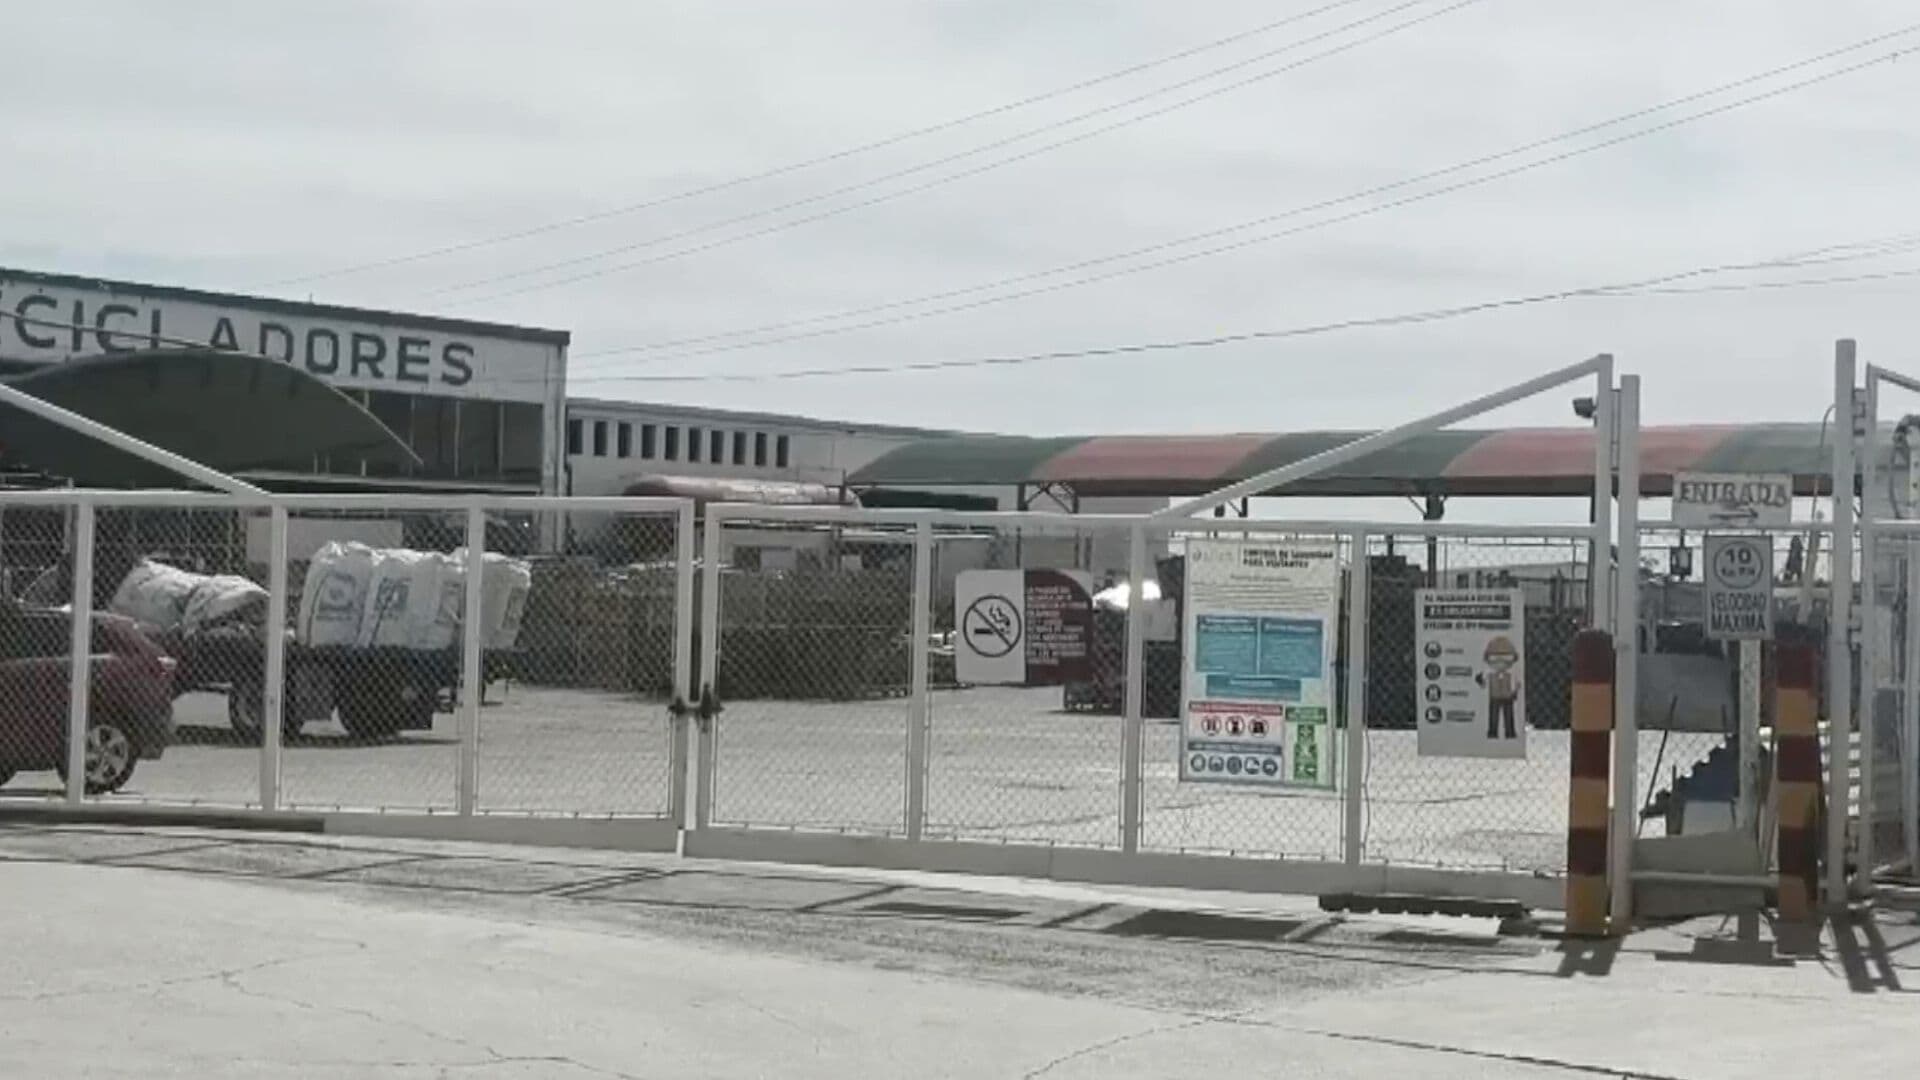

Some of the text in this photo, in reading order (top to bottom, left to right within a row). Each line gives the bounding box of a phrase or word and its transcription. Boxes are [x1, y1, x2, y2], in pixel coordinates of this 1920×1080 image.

[1680, 482, 1788, 507] ENTRADA
[1725, 548, 1752, 564] 10
[1711, 592, 1768, 612] VELOCIDAD
[1711, 613, 1767, 633] MAXIMA
